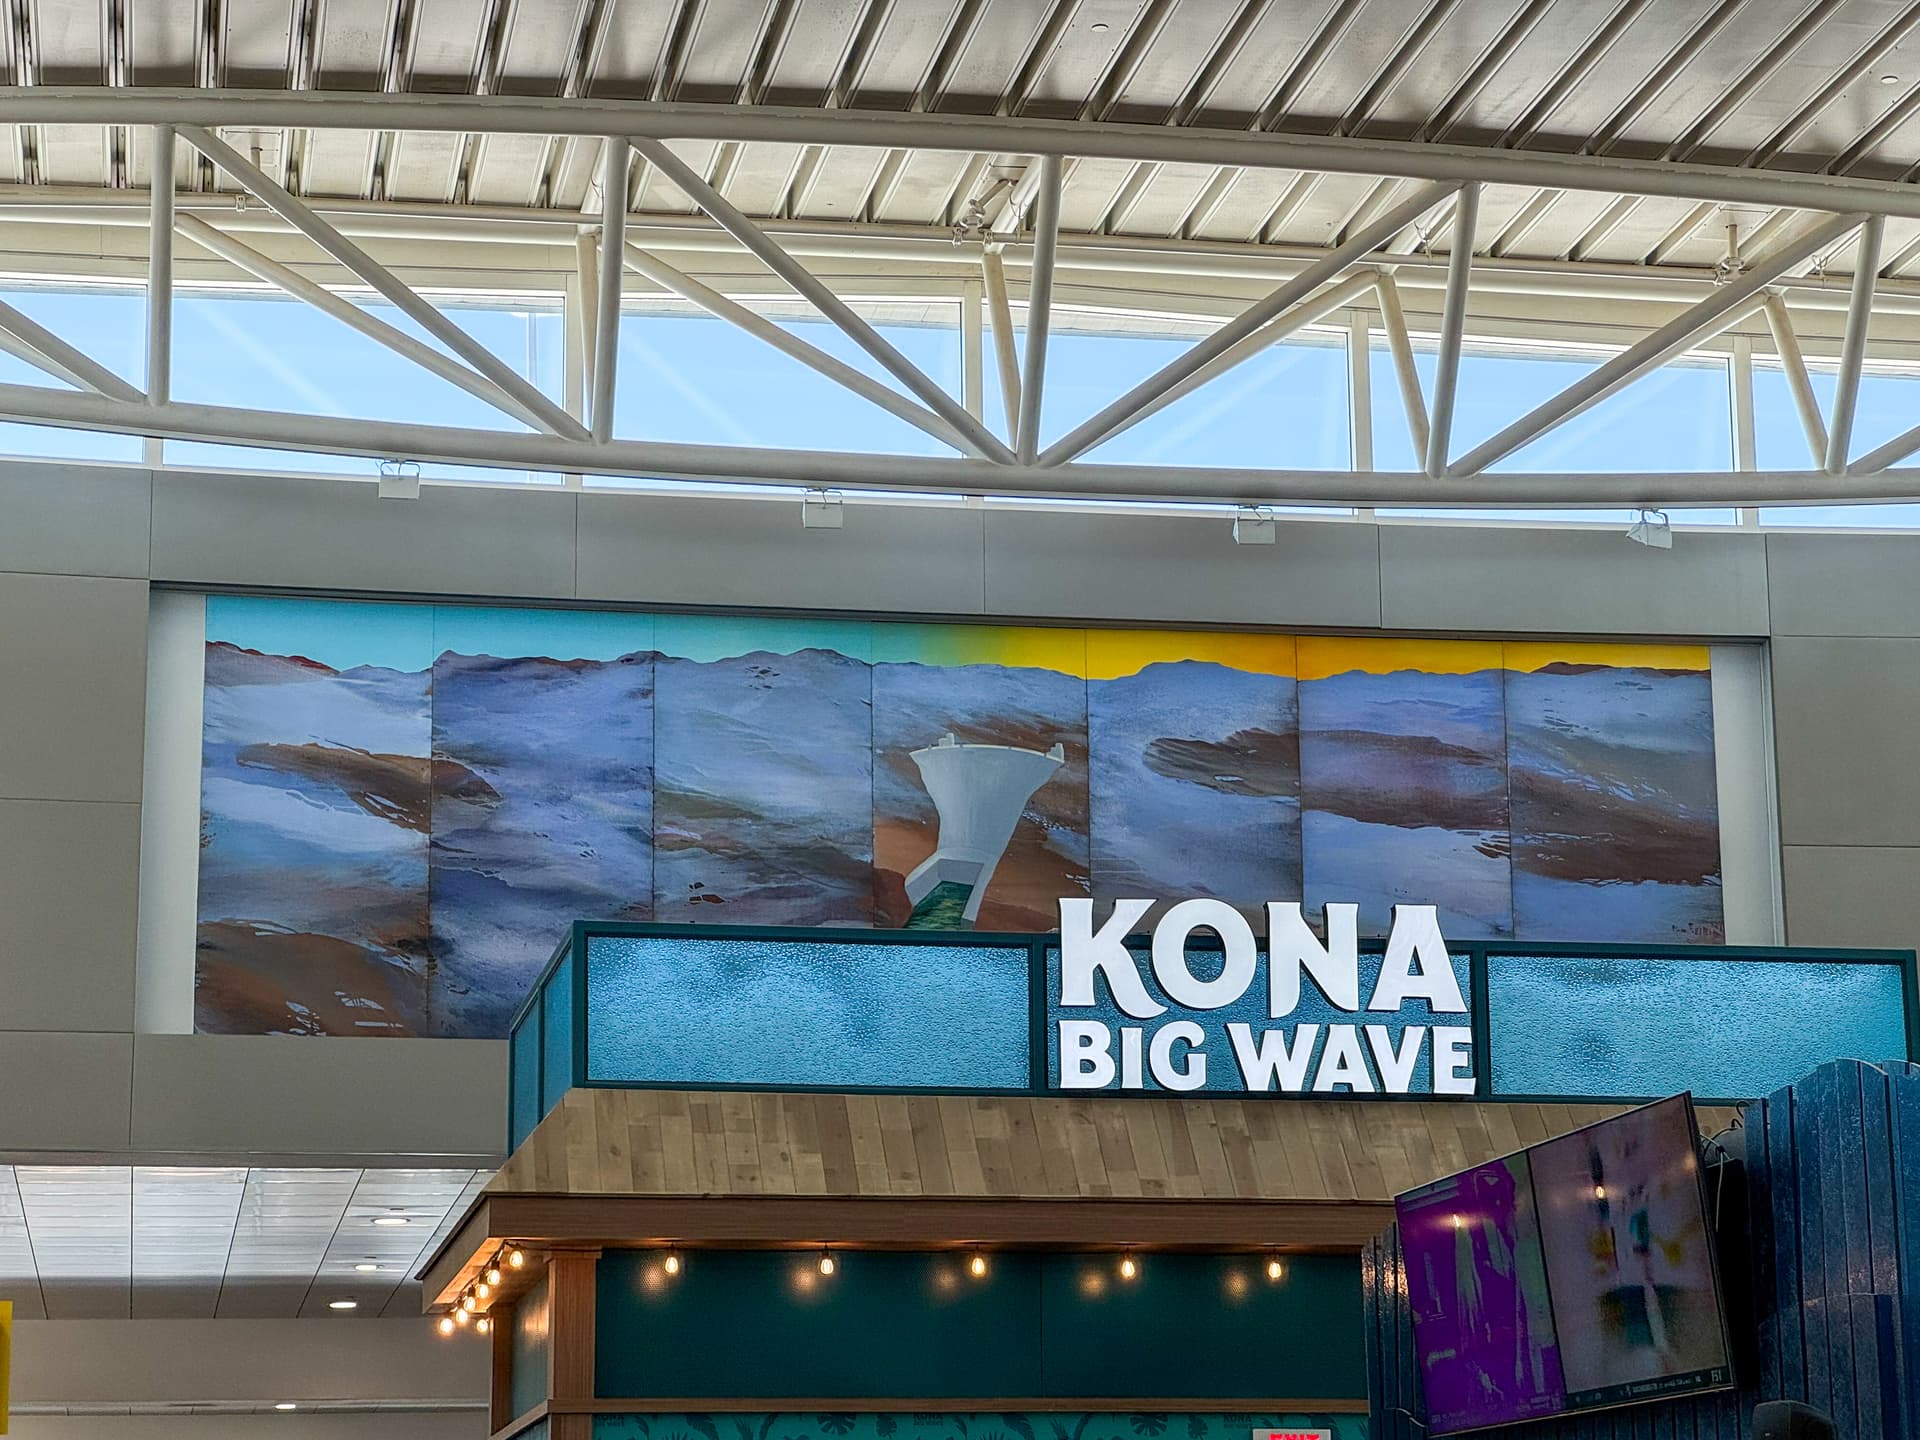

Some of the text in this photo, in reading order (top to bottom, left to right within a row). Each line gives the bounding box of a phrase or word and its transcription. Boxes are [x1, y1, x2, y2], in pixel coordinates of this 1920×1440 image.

[1058, 897, 1468, 1019] KONA
[1058, 1020, 1477, 1095] BIG WAVE
